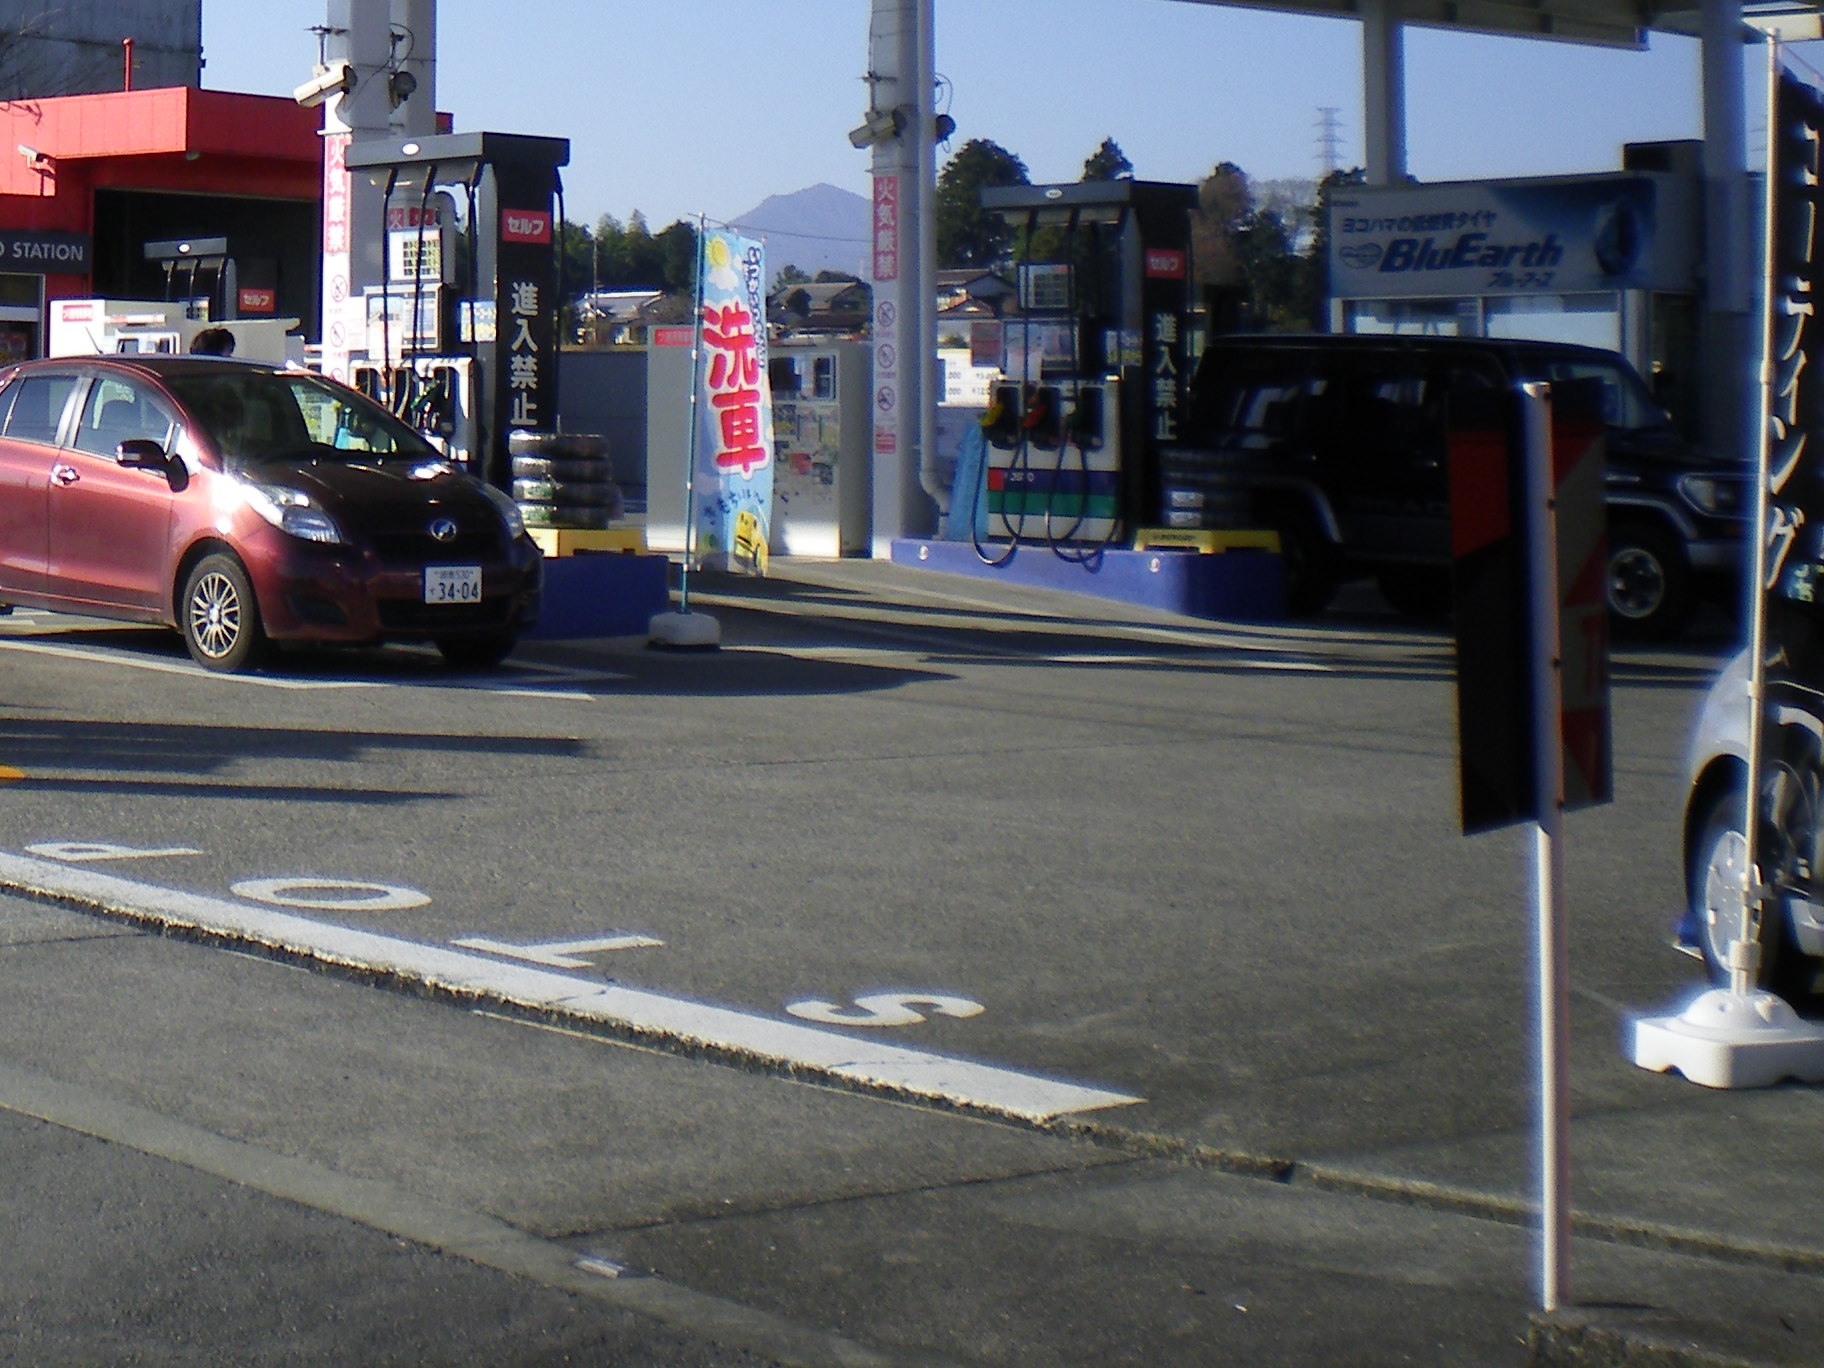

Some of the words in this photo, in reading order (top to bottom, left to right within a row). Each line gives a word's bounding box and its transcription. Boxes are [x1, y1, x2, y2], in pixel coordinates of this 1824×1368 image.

[327, 136, 347, 250] 火気厳禁
[506, 217, 545, 236] セルフ
[12, 241, 84, 262] STATION
[876, 179, 896, 278] 火気厳禁
[1151, 255, 1180, 271] セルフ
[1377, 232, 1564, 273] BluEarth
[242, 292, 270, 307] セルフ
[511, 282, 538, 426] 進入禁止
[702, 300, 767, 473] 洗車
[1155, 312, 1178, 440] 進入禁止
[438, 581, 478, 601] 34-04
[24, 839, 986, 1029] STOP
